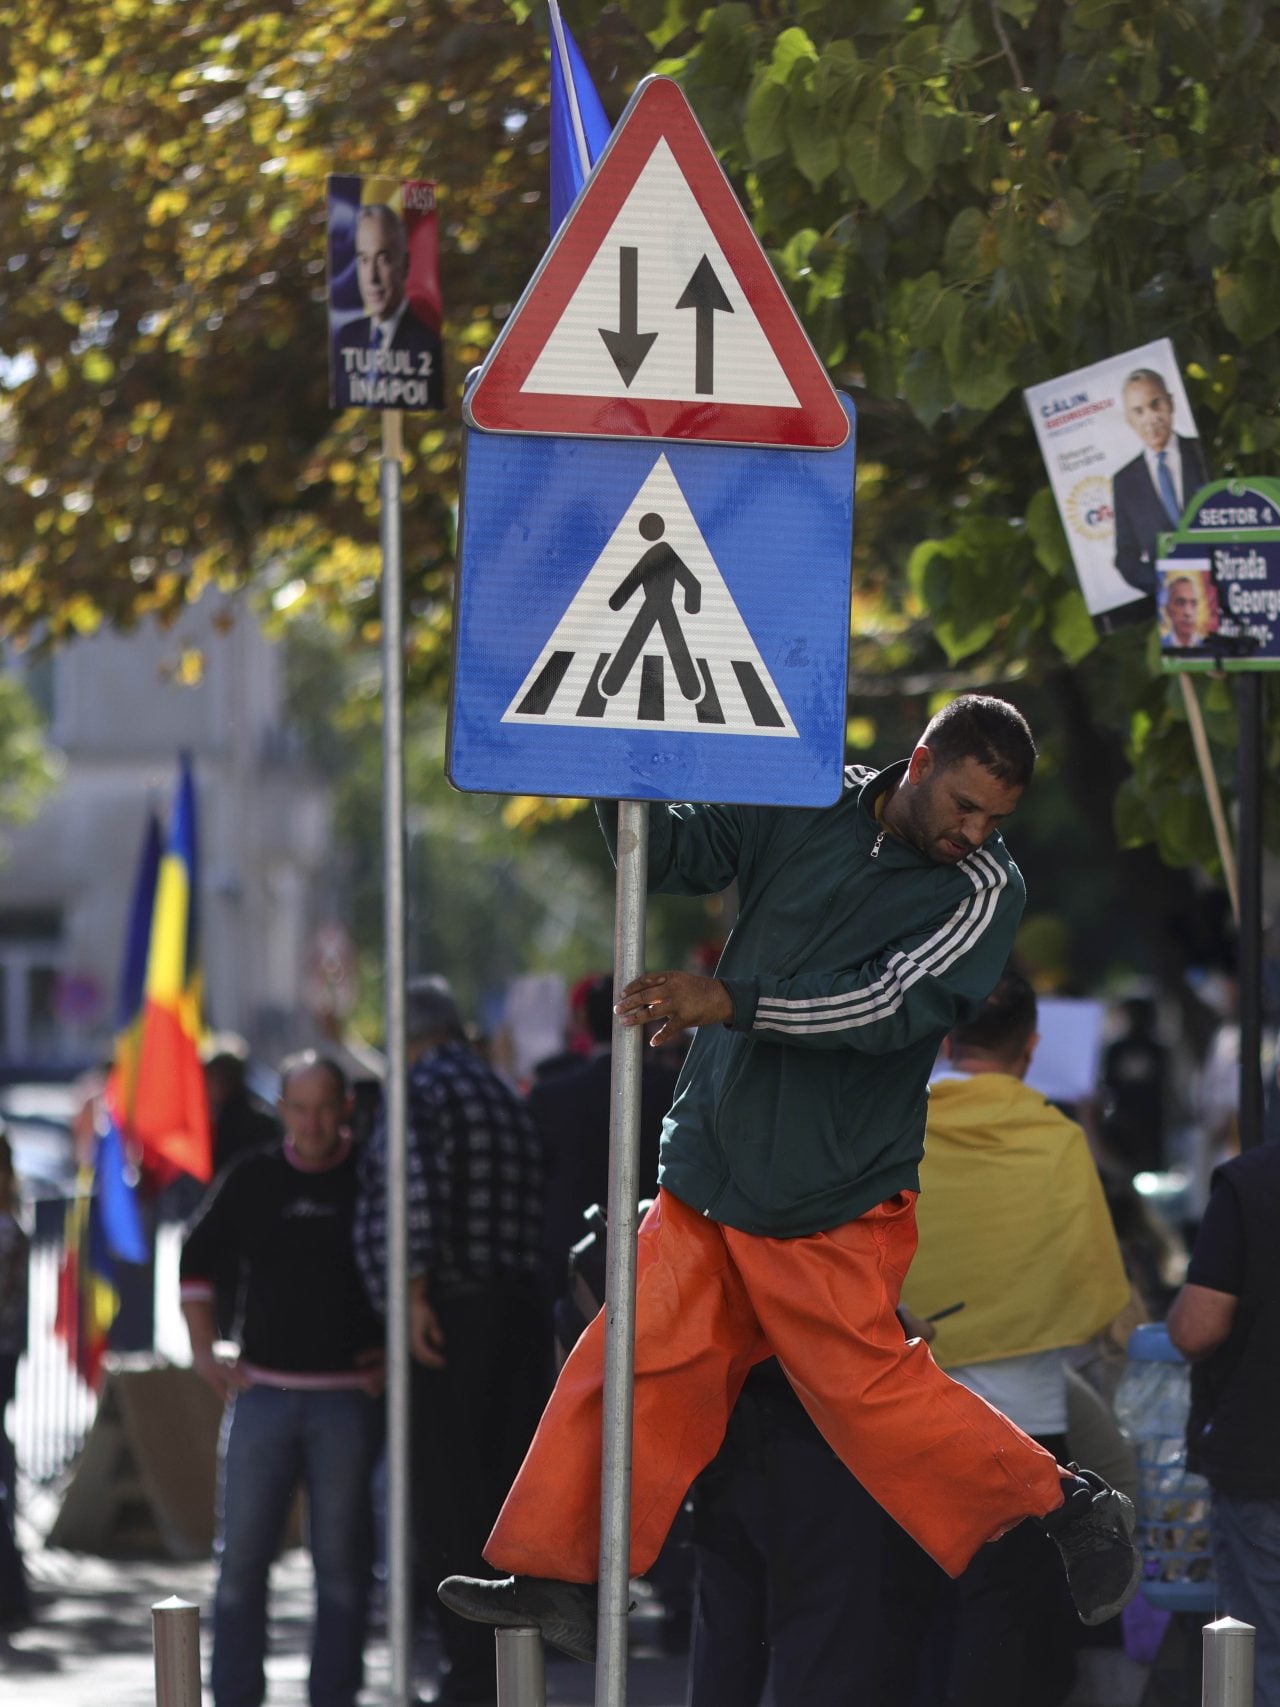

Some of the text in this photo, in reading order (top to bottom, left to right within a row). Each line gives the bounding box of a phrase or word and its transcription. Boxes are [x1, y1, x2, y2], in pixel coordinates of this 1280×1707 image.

[341, 346, 433, 377] TURUL 2
[1199, 506, 1273, 526] SECTOR 4
[1213, 549, 1267, 580] Strada
